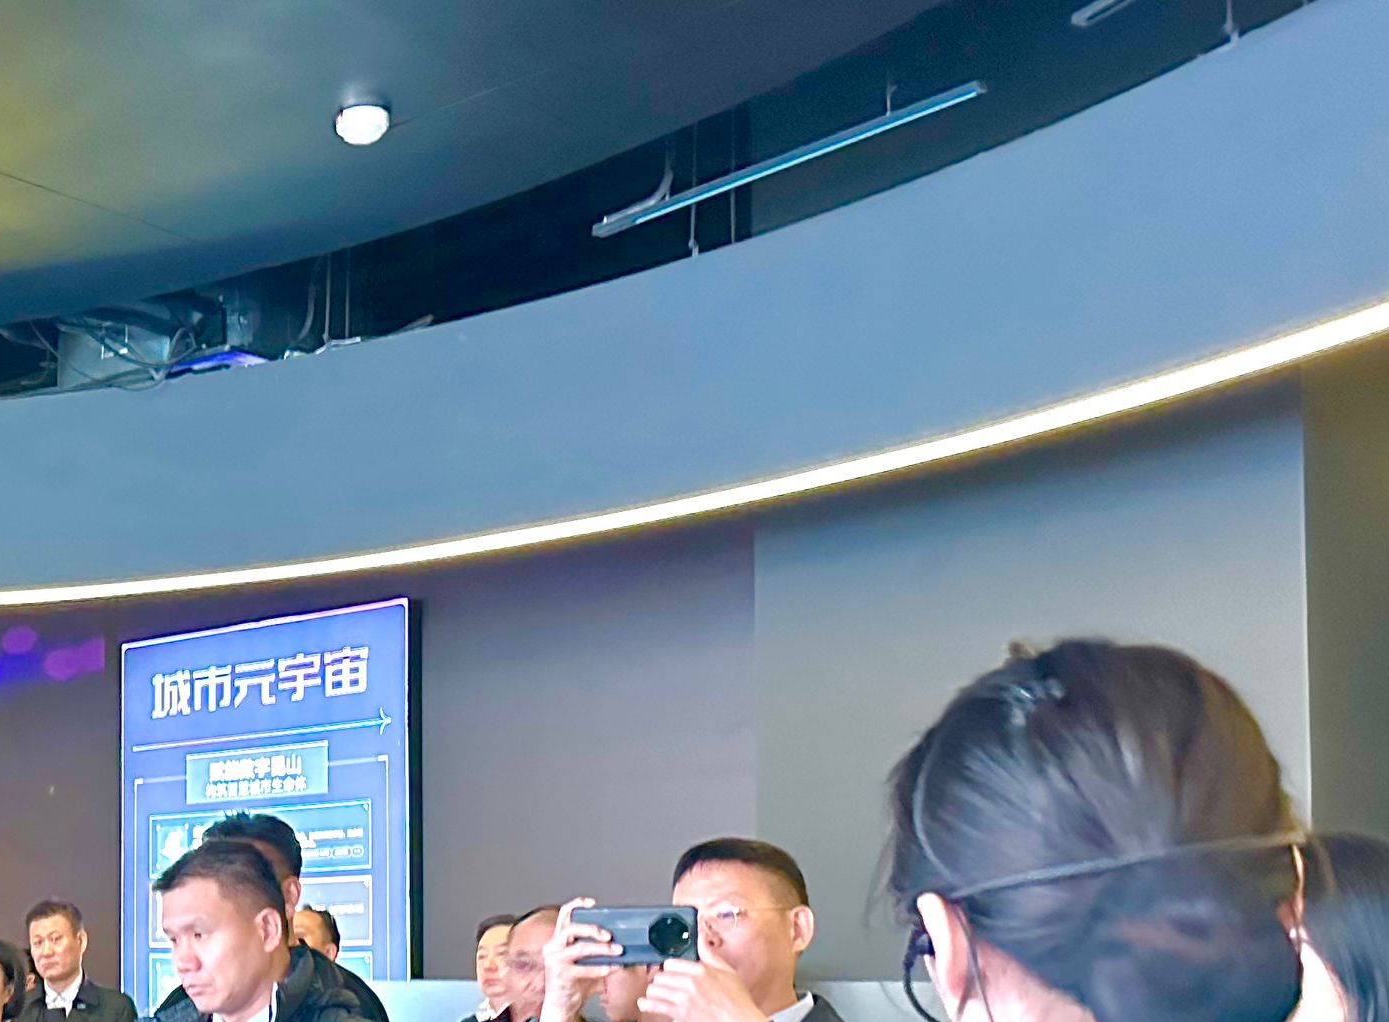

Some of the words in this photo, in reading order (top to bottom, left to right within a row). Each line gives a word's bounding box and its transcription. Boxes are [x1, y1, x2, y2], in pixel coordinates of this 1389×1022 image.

[152, 646, 369, 719] 城市元宇宙
